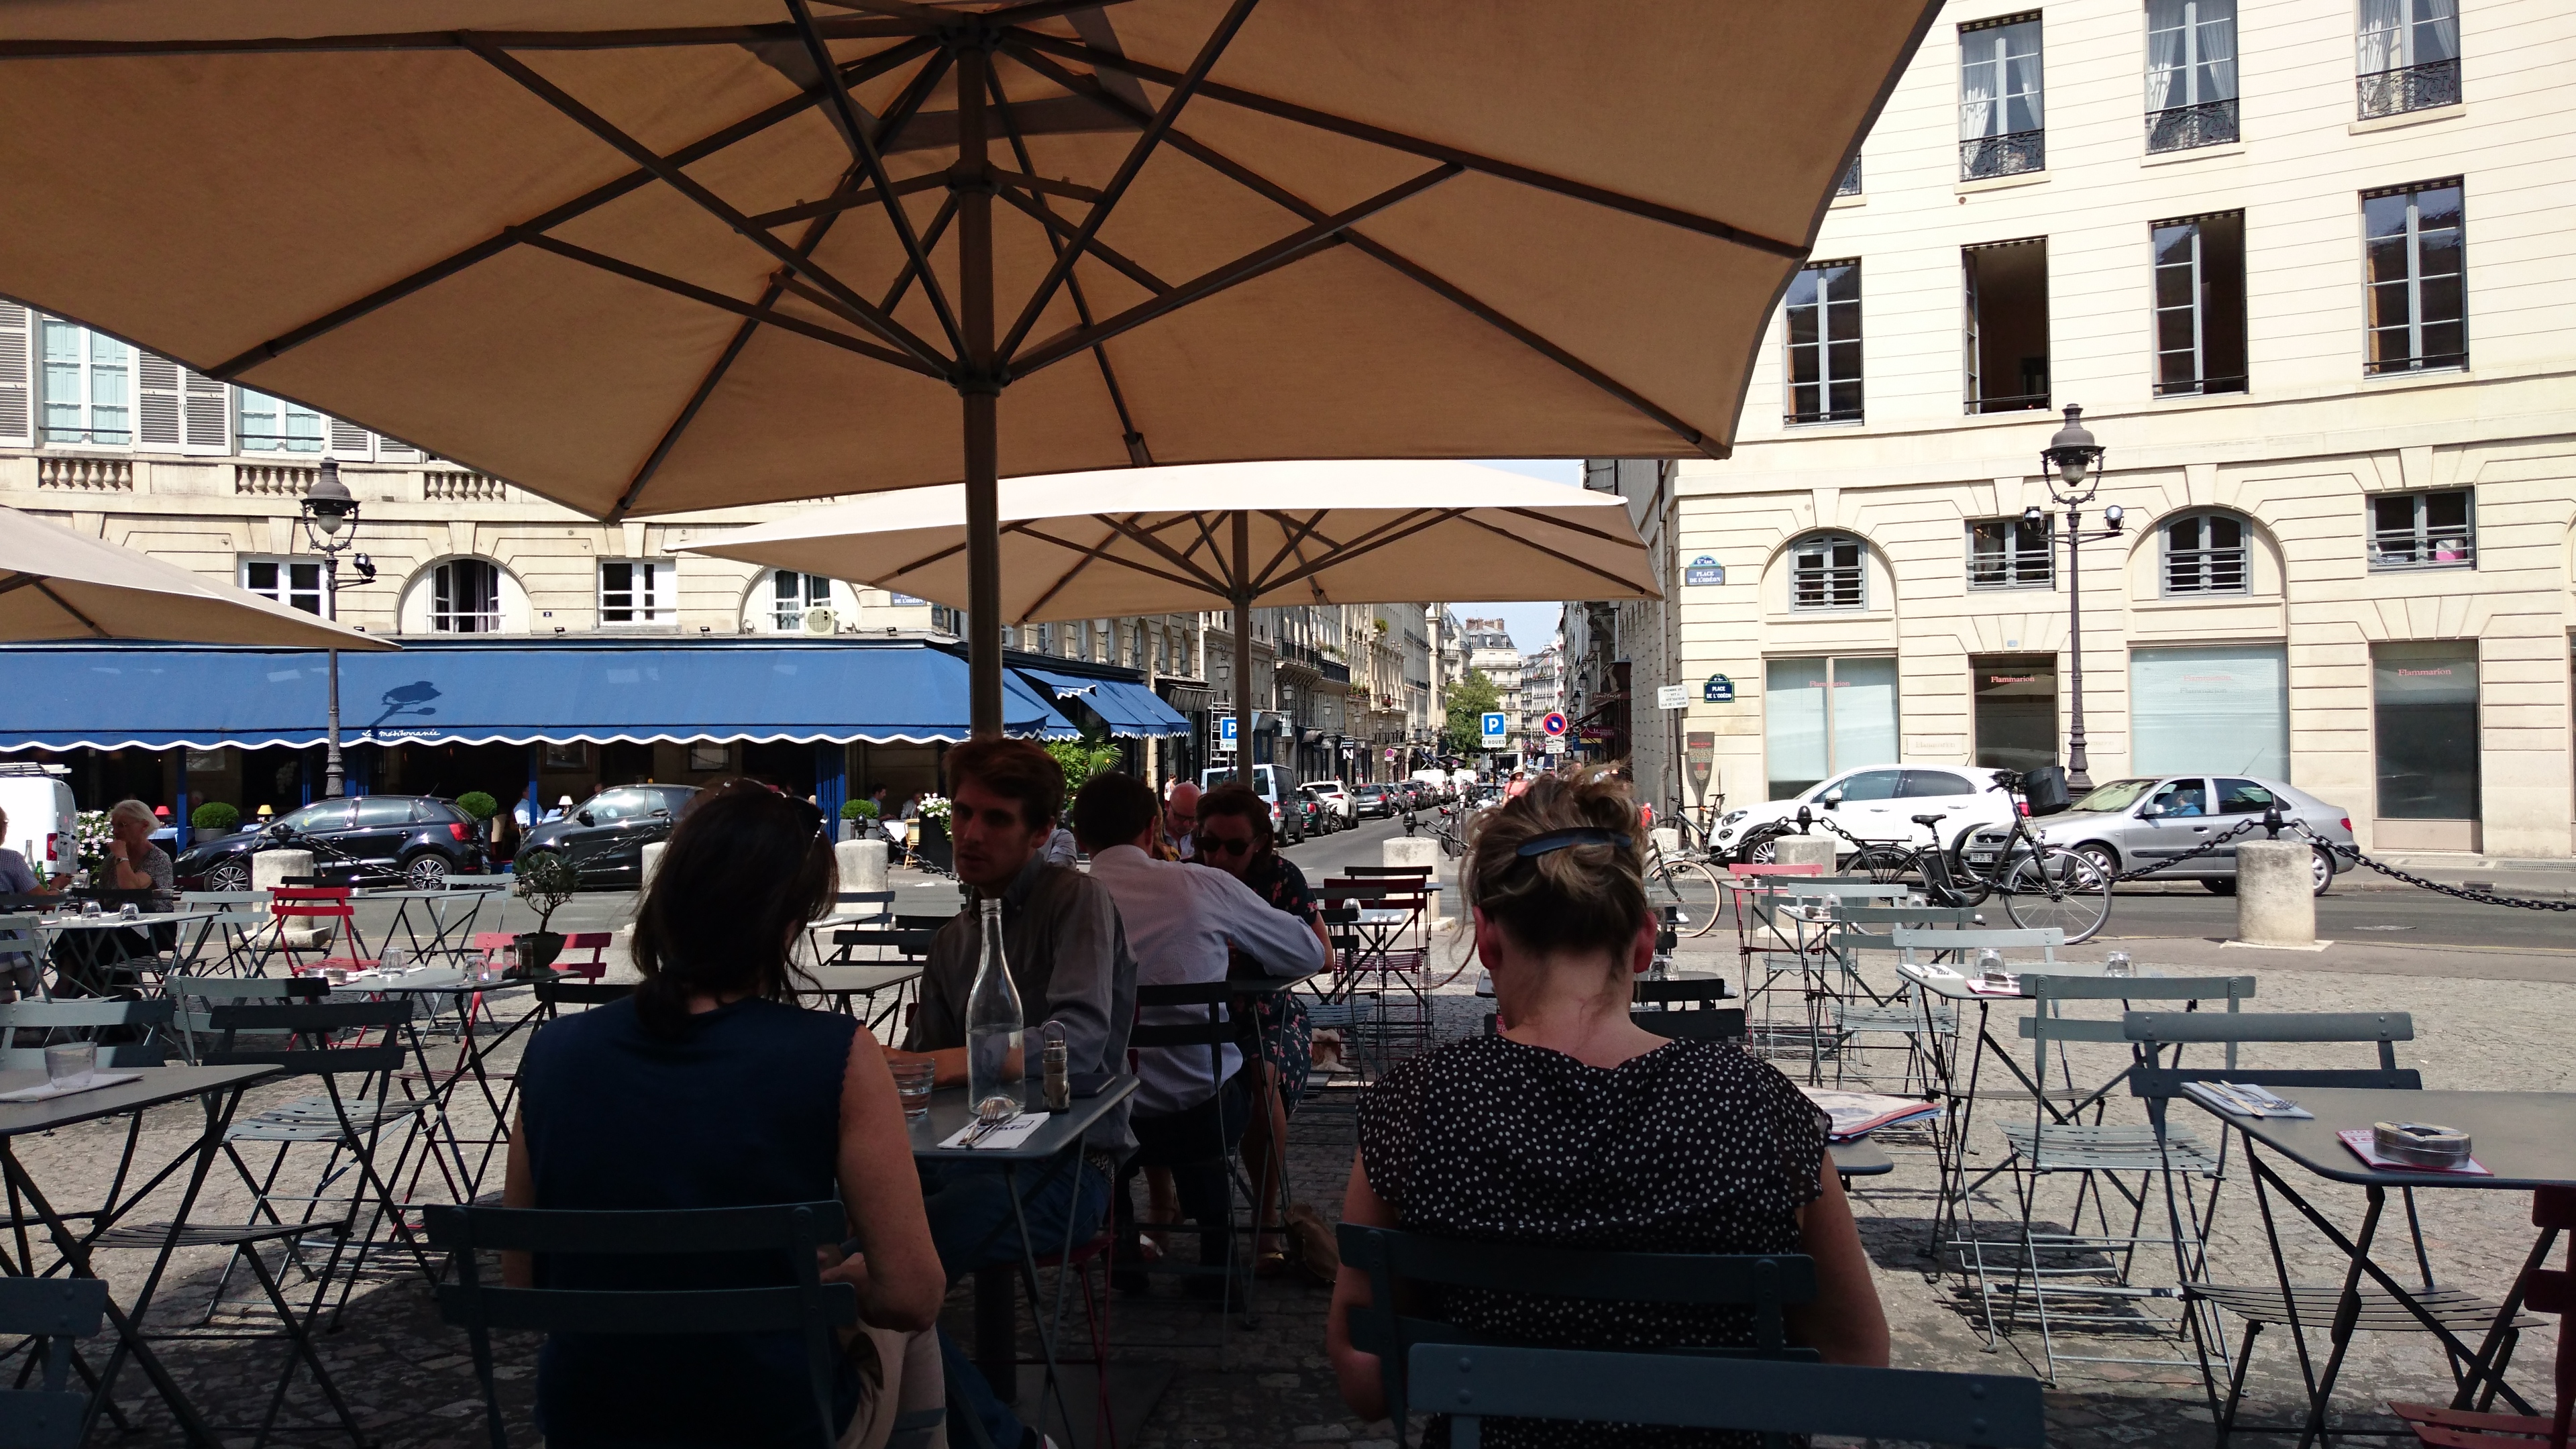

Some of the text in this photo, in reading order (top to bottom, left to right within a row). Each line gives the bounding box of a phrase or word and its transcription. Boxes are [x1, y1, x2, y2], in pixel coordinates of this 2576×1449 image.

[2398, 667, 2452, 676] Flammarion
[1228, 722, 1237, 737] P
[1489, 718, 1499, 733] P
[362, 729, 374, 737] La
[1343, 749, 1354, 759] N
